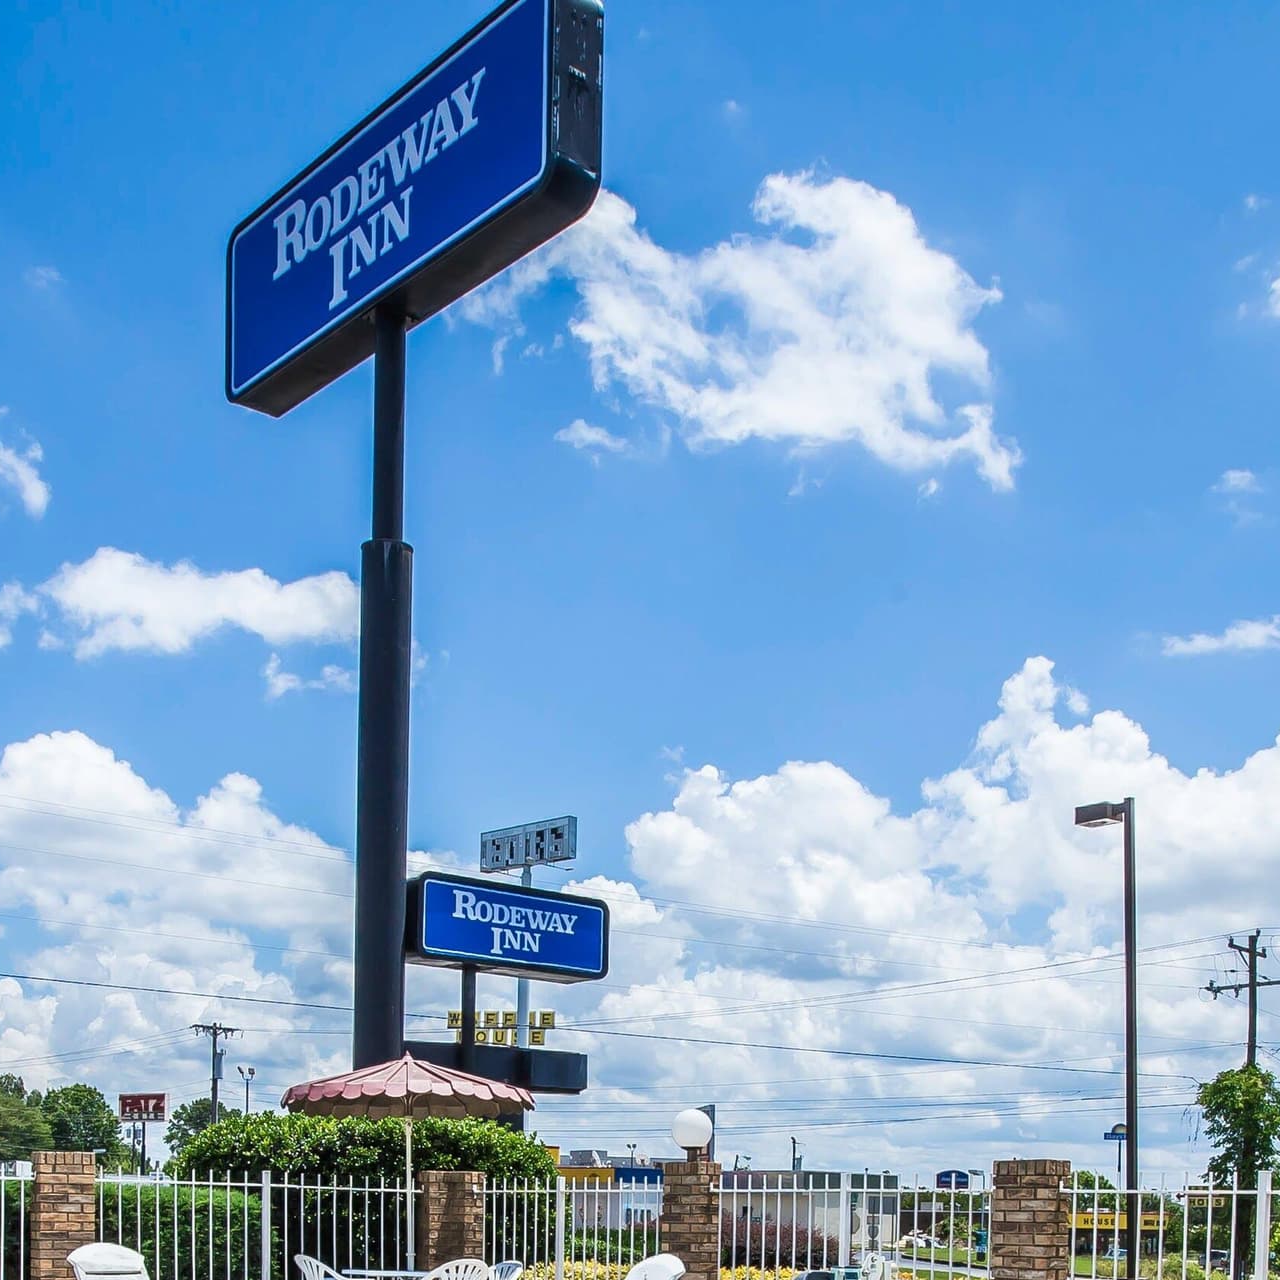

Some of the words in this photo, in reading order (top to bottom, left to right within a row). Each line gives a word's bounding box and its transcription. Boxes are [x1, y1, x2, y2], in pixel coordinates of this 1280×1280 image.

[273, 67, 486, 281] RODEWAY
[328, 186, 413, 311] INN
[452, 889, 578, 935] RODEWAY
[490, 927, 541, 954] INN
[449, 1013, 552, 1025] WFFE
[458, 1031, 542, 1043] OUE
